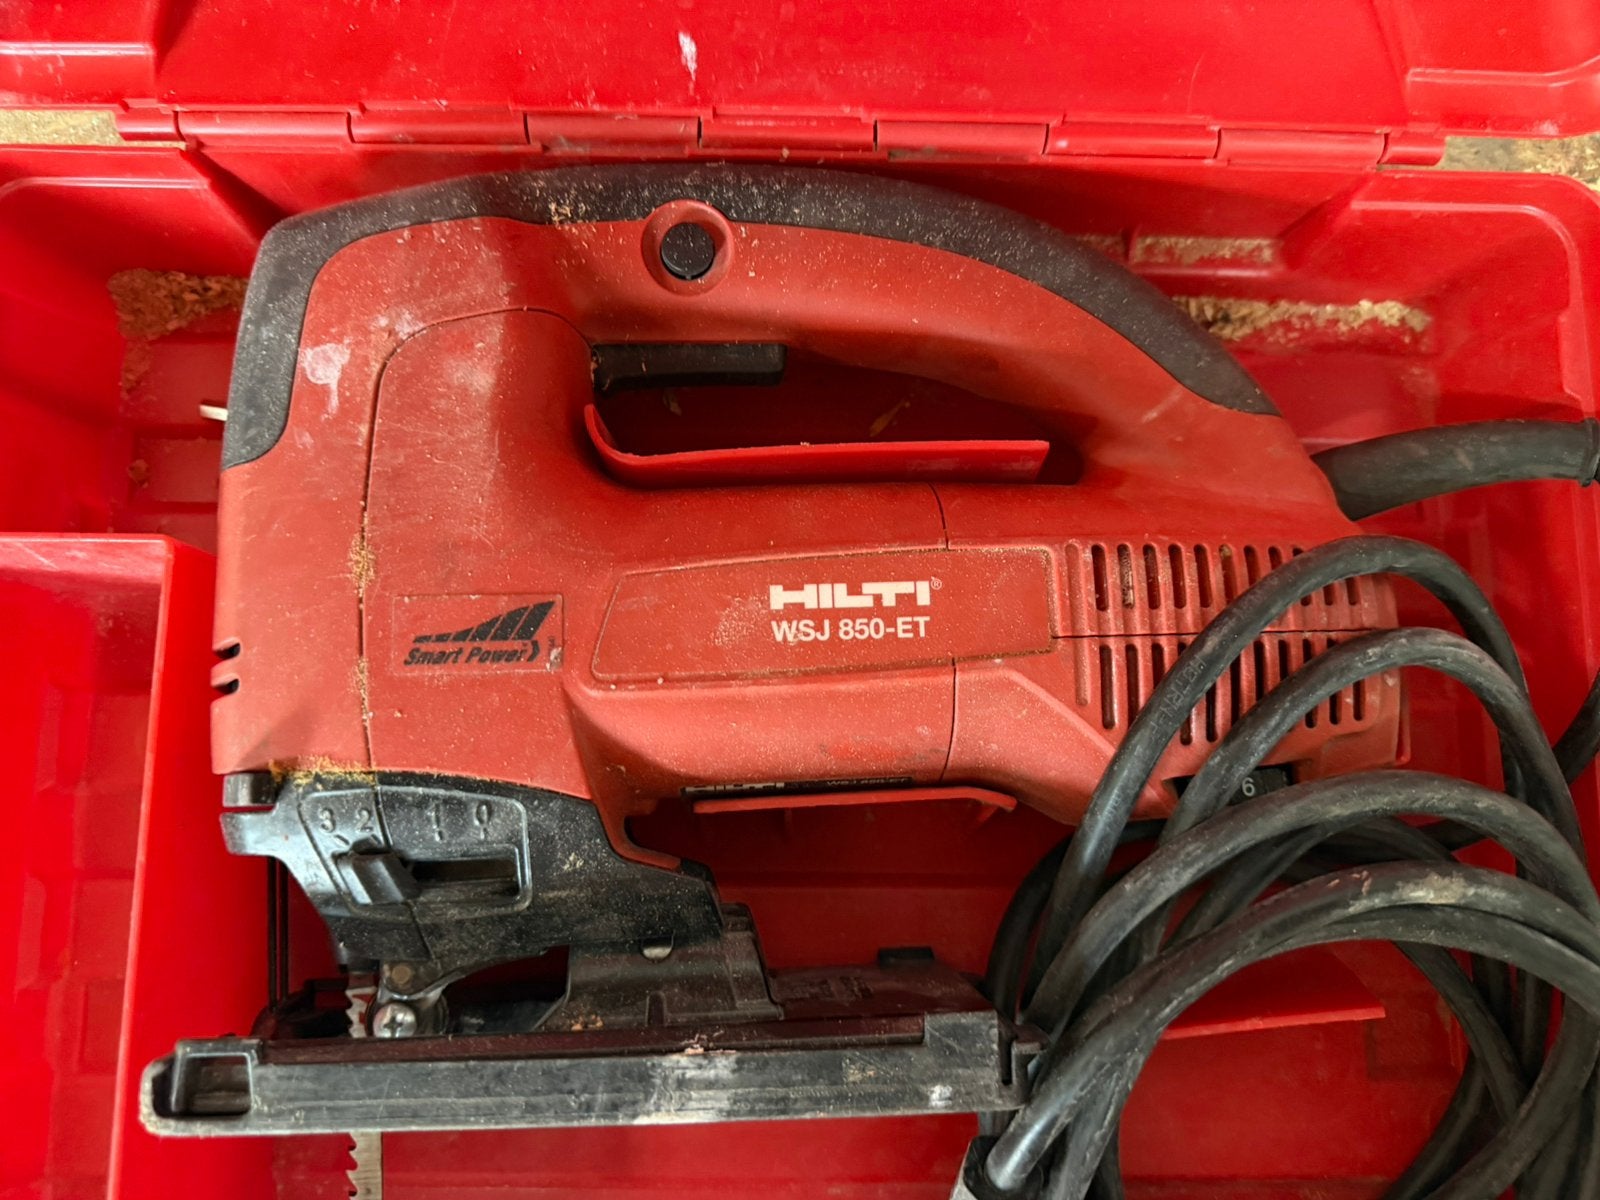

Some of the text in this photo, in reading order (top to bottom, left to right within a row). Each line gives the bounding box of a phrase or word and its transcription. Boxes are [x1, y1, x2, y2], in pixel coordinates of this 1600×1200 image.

[770, 615, 931, 642] WSJ 850-ET
[403, 647, 465, 666] Smart
[465, 642, 529, 664] Power
[1241, 777, 1256, 797] 6
[318, 807, 336, 834] 3
[355, 807, 375, 833] 2
